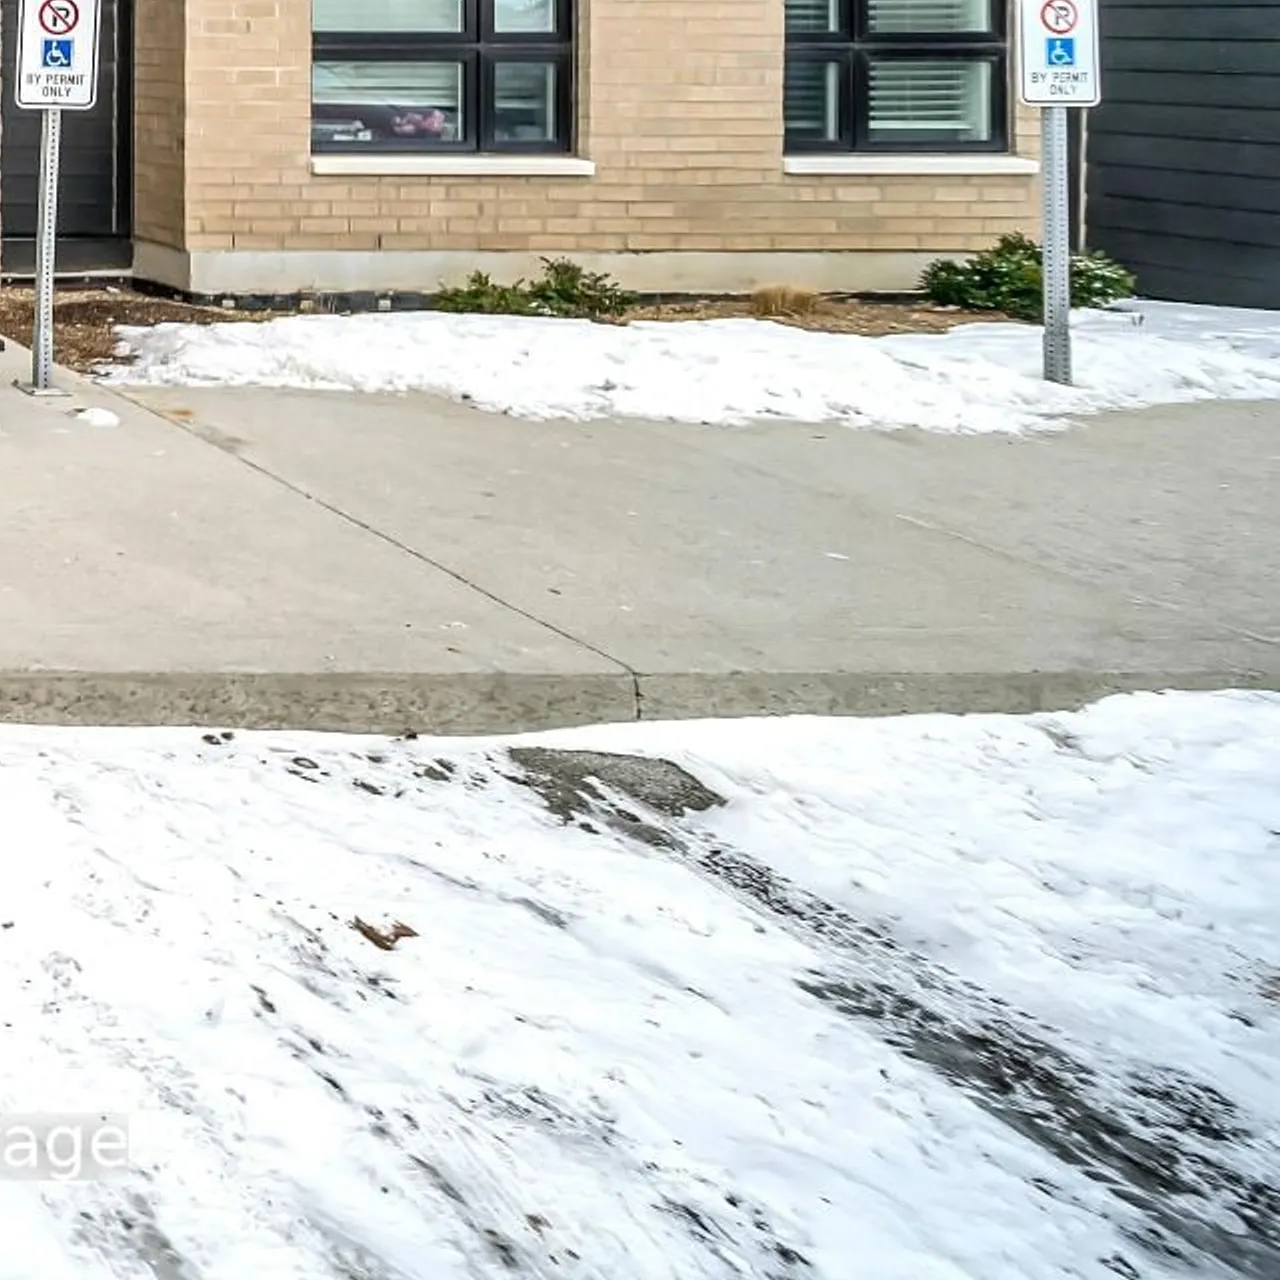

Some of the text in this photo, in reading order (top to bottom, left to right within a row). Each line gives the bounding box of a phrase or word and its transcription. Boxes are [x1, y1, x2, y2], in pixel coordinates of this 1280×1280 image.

[26, 74, 86, 85] BY PERMIT
[1030, 72, 1089, 83] BY PERMIT
[41, 86, 72, 98] ONLY
[1049, 84, 1078, 96] ONLY
